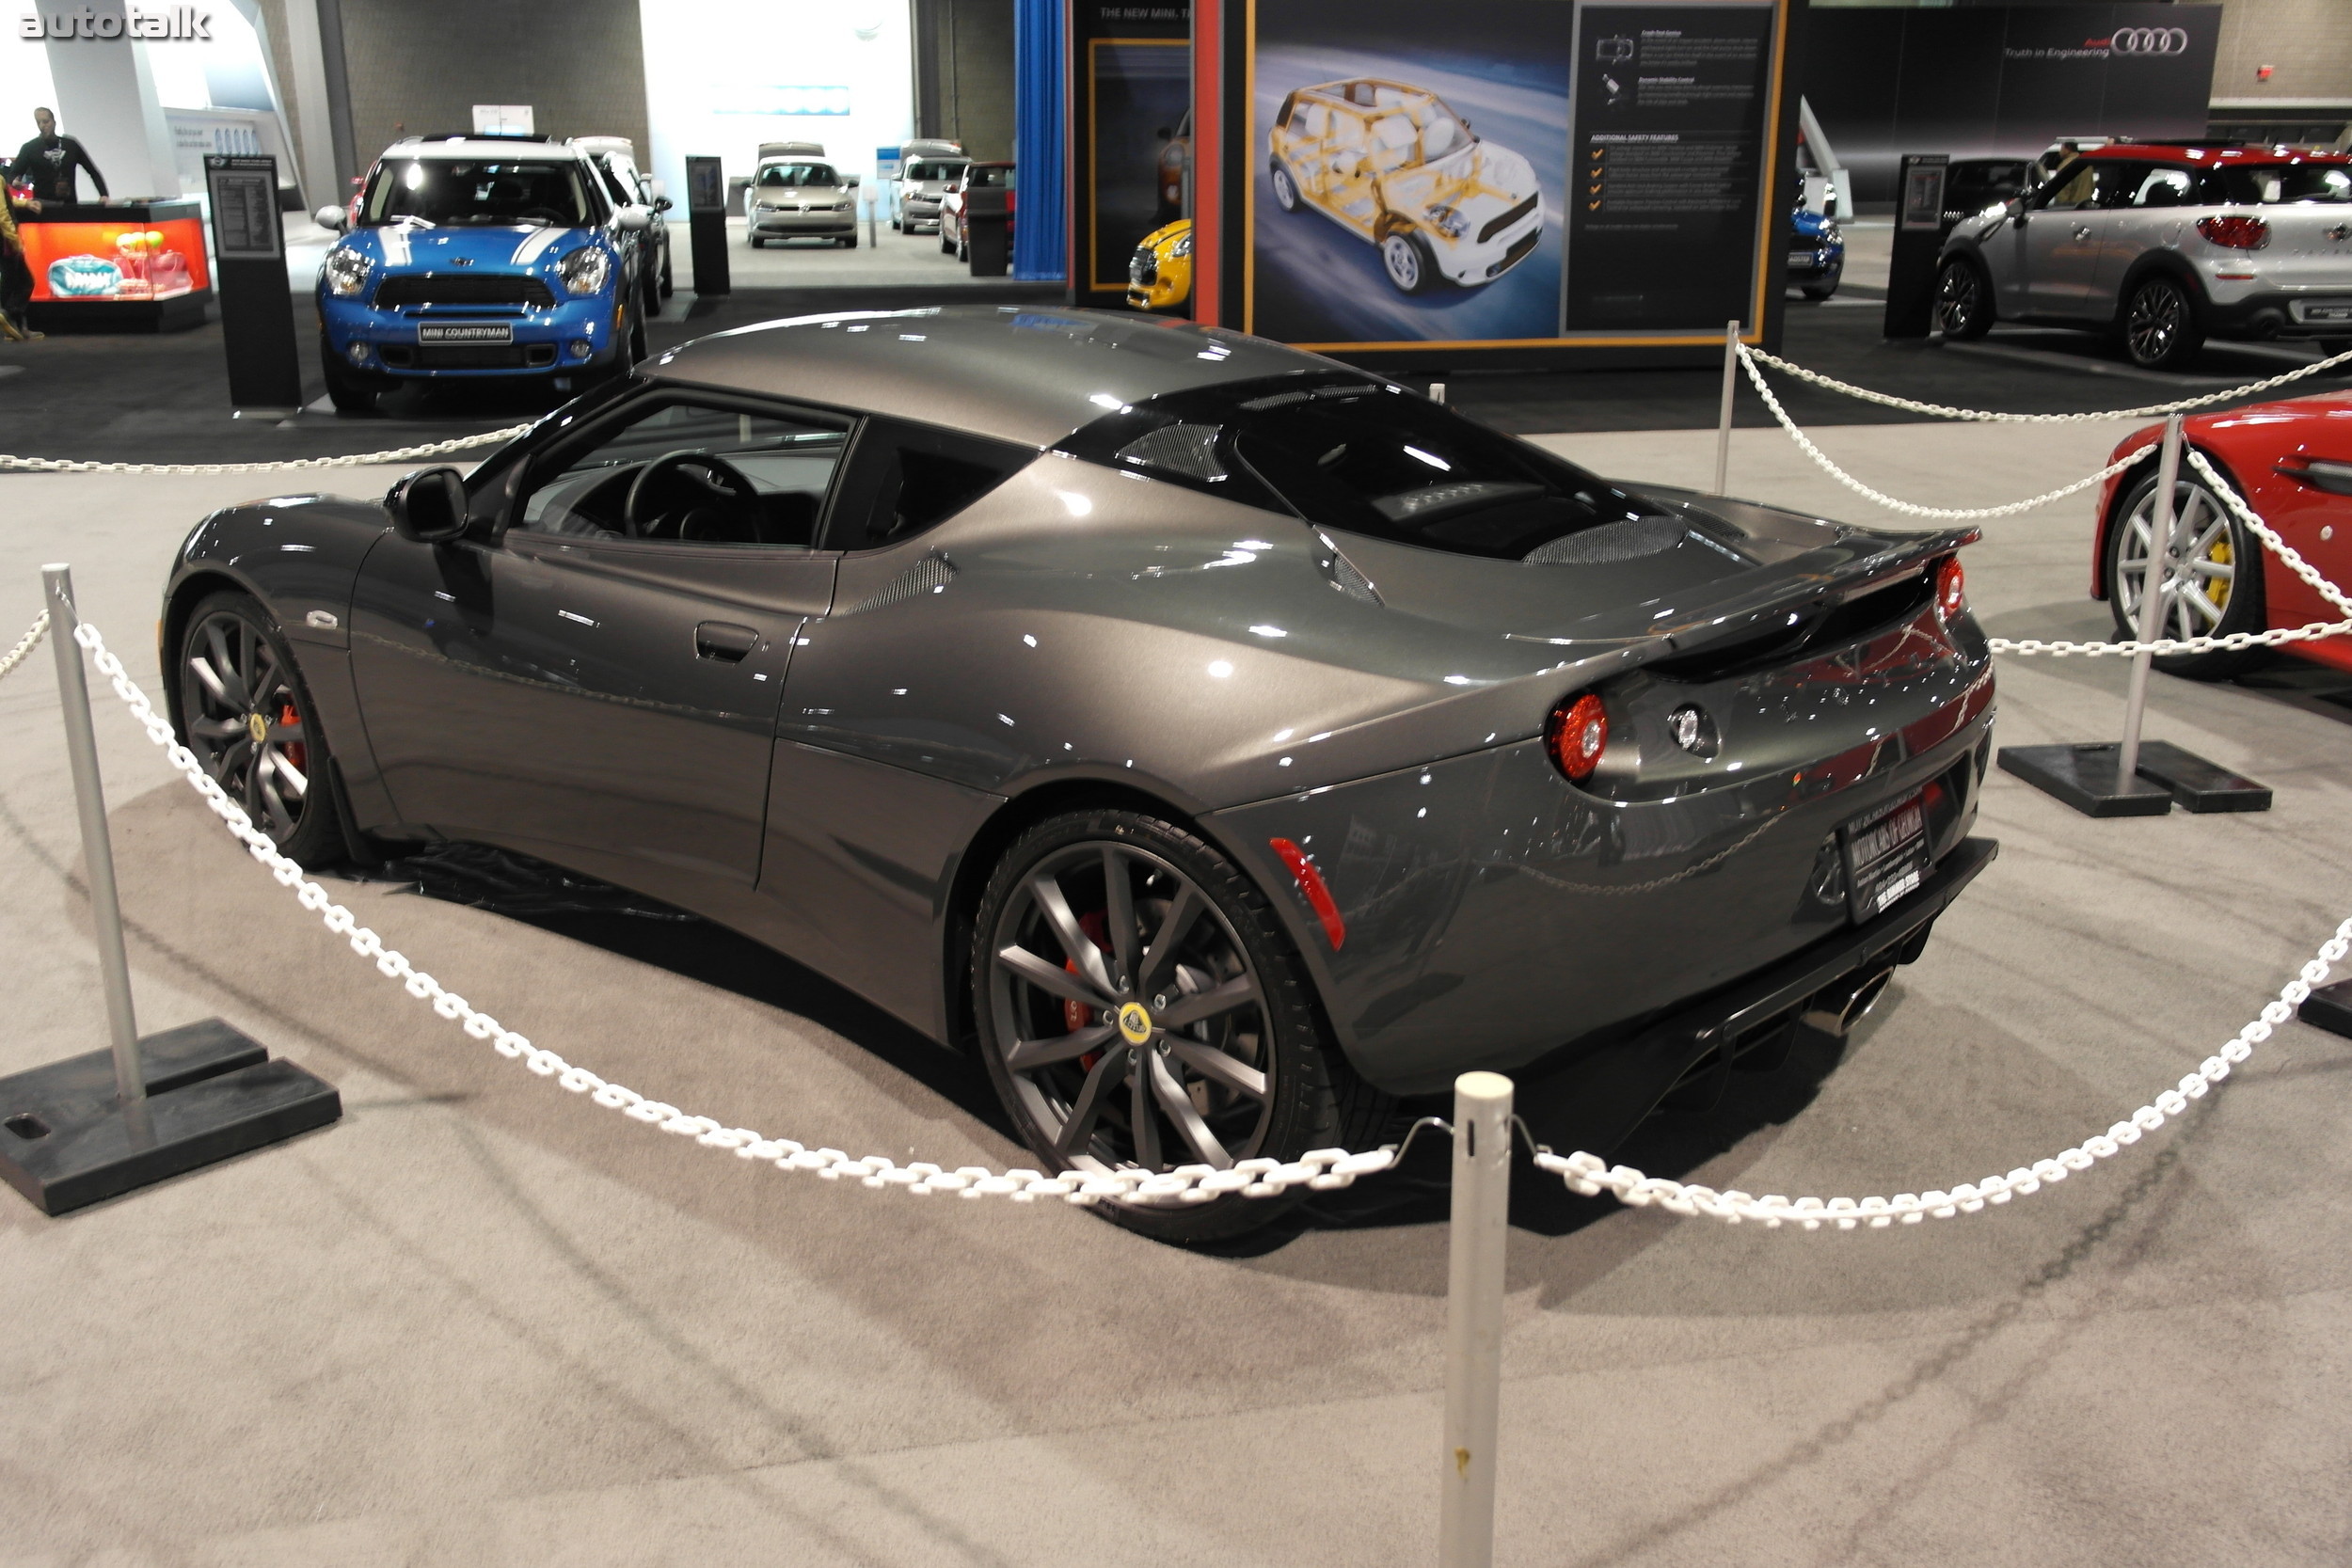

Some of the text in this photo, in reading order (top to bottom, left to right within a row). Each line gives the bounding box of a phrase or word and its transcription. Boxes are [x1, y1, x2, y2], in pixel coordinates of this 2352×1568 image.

[1100, 8, 1120, 19] THE
[1123, 8, 1148, 19] NEW
[2084, 38, 2111, 47] Audi
[2004, 48, 2109, 59] Truth in Engineering
[1590, 135, 1678, 143] ADDITIONAL SAFETY FEATURES
[422, 328, 508, 339] MINI COUNTRYMAN
